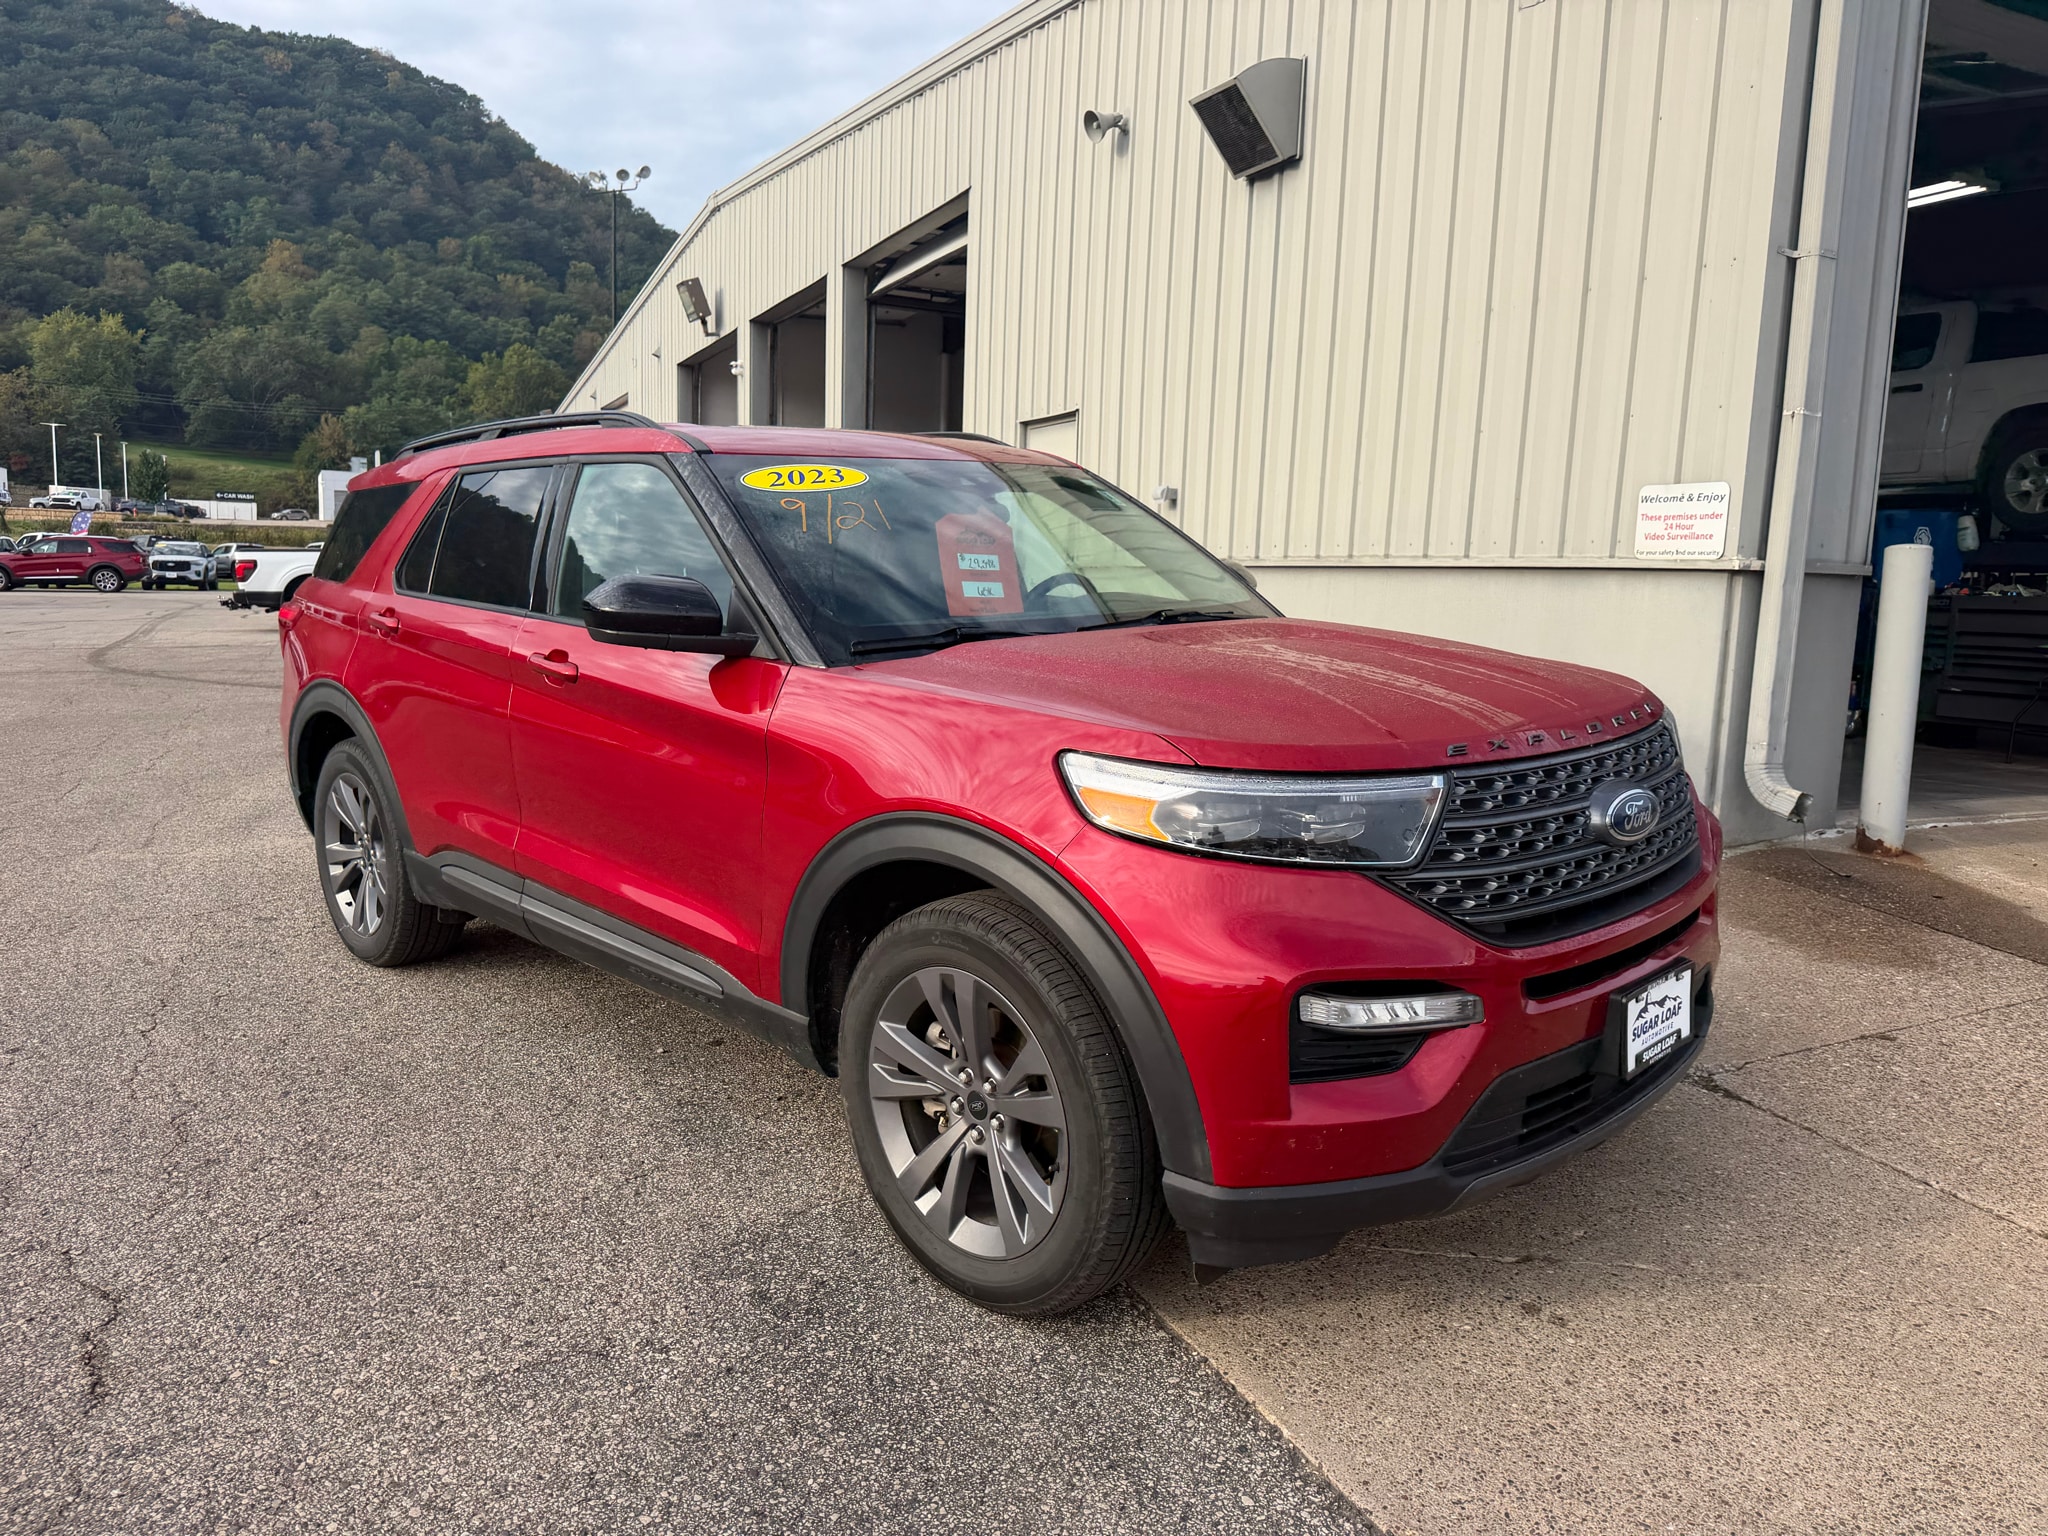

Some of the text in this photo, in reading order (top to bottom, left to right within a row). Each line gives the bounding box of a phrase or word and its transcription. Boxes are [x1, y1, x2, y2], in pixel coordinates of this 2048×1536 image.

[767, 468, 845, 487] 2023
[1640, 492, 1726, 504] Welcome & Enjoy
[780, 493, 892, 544] 9/21
[1640, 511, 1723, 523] These premises under
[1675, 522, 1694, 530] Hour
[1644, 531, 1714, 541] Video Surveillance
[1446, 702, 1656, 757] EXPLORER
[1624, 799, 1652, 831] Ford
[1631, 1001, 1683, 1043] SUGAR LOAF
[1640, 1021, 1674, 1046] AUTOMOTIVE
[1642, 1033, 1677, 1062] SUGAR LOAF
